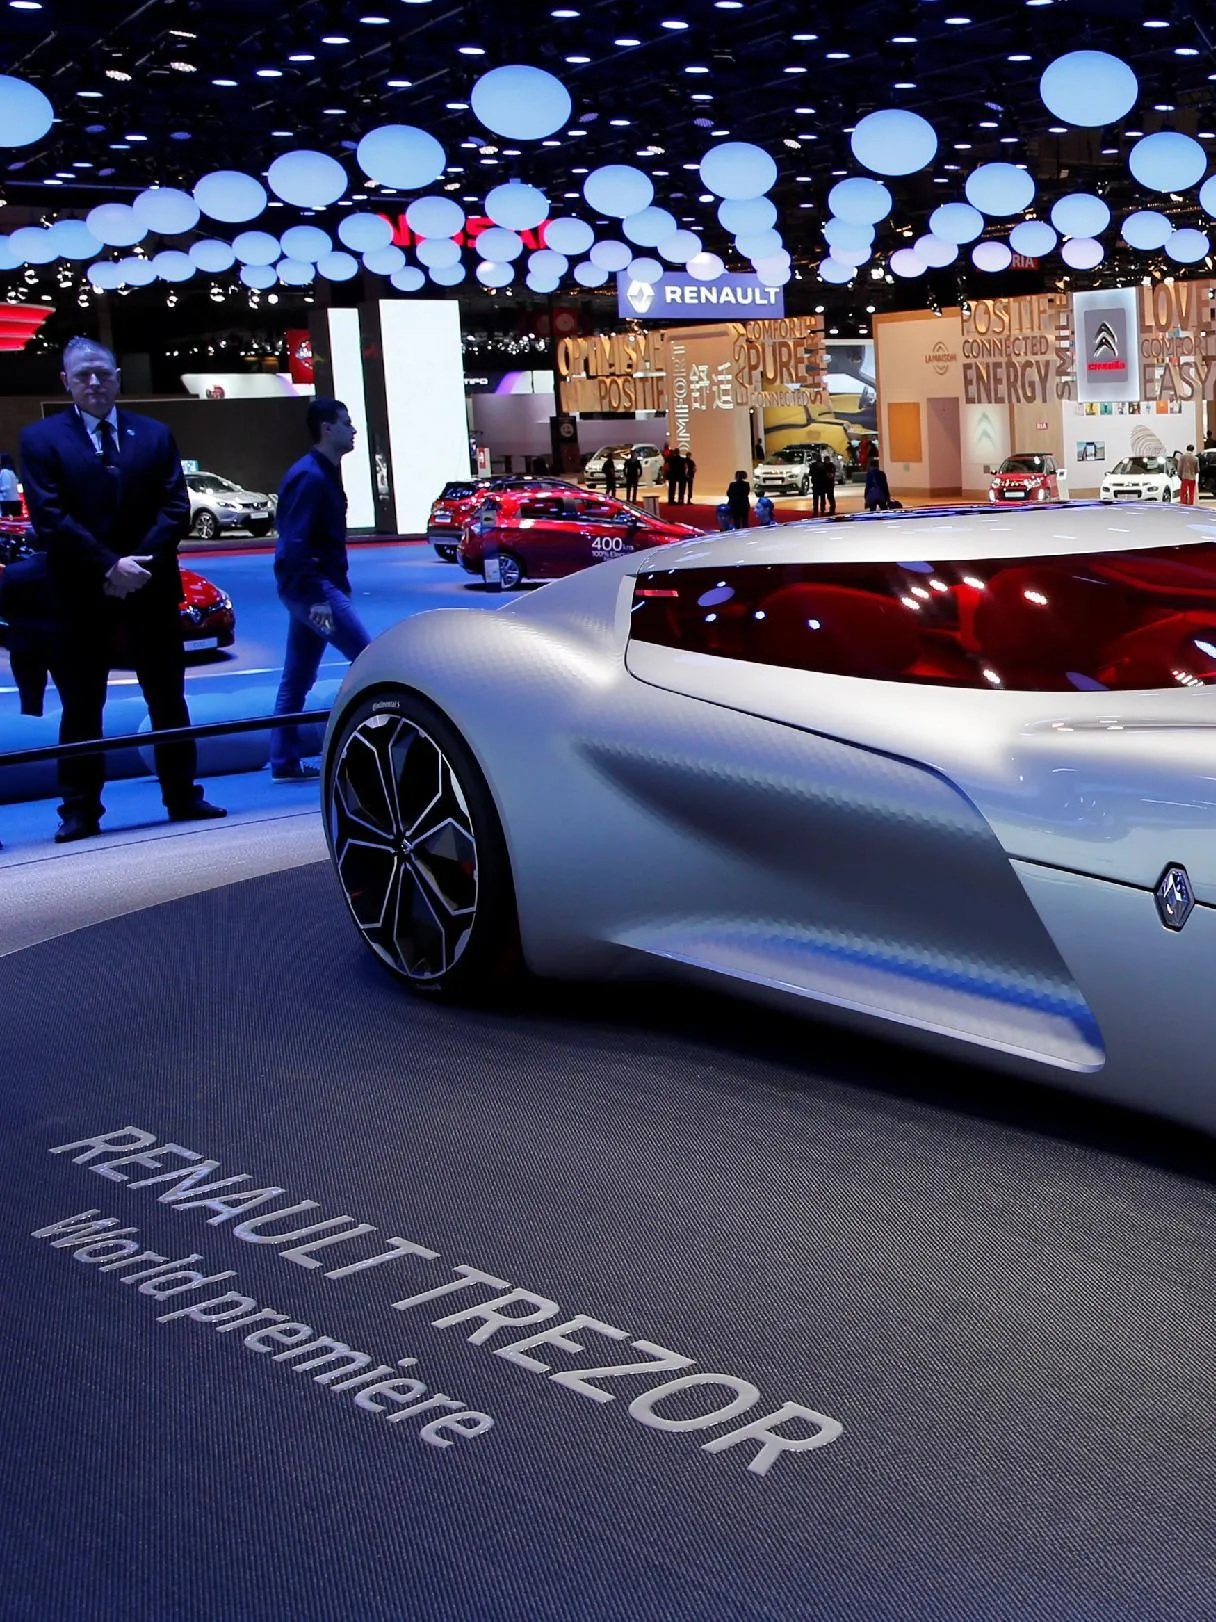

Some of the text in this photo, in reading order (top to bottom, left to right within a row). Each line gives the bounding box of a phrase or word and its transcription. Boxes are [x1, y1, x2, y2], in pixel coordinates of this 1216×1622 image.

[664, 286, 780, 305] RENAULT
[1139, 282, 1212, 333] LOVE
[746, 318, 806, 340] COMFORT
[962, 336, 1049, 359] CONNECTED
[1055, 294, 1074, 400] SMILE
[1141, 335, 1210, 358] COMFORT
[746, 340, 808, 386] PURE
[963, 359, 1050, 404] ENERGY
[1143, 360, 1213, 401] EASY
[600, 376, 668, 411] POSITIF
[592, 537, 622, 551] 400
[48, 1126, 843, 1477] RENAULT TREZOR
[31, 1209, 495, 1449] World premiere
